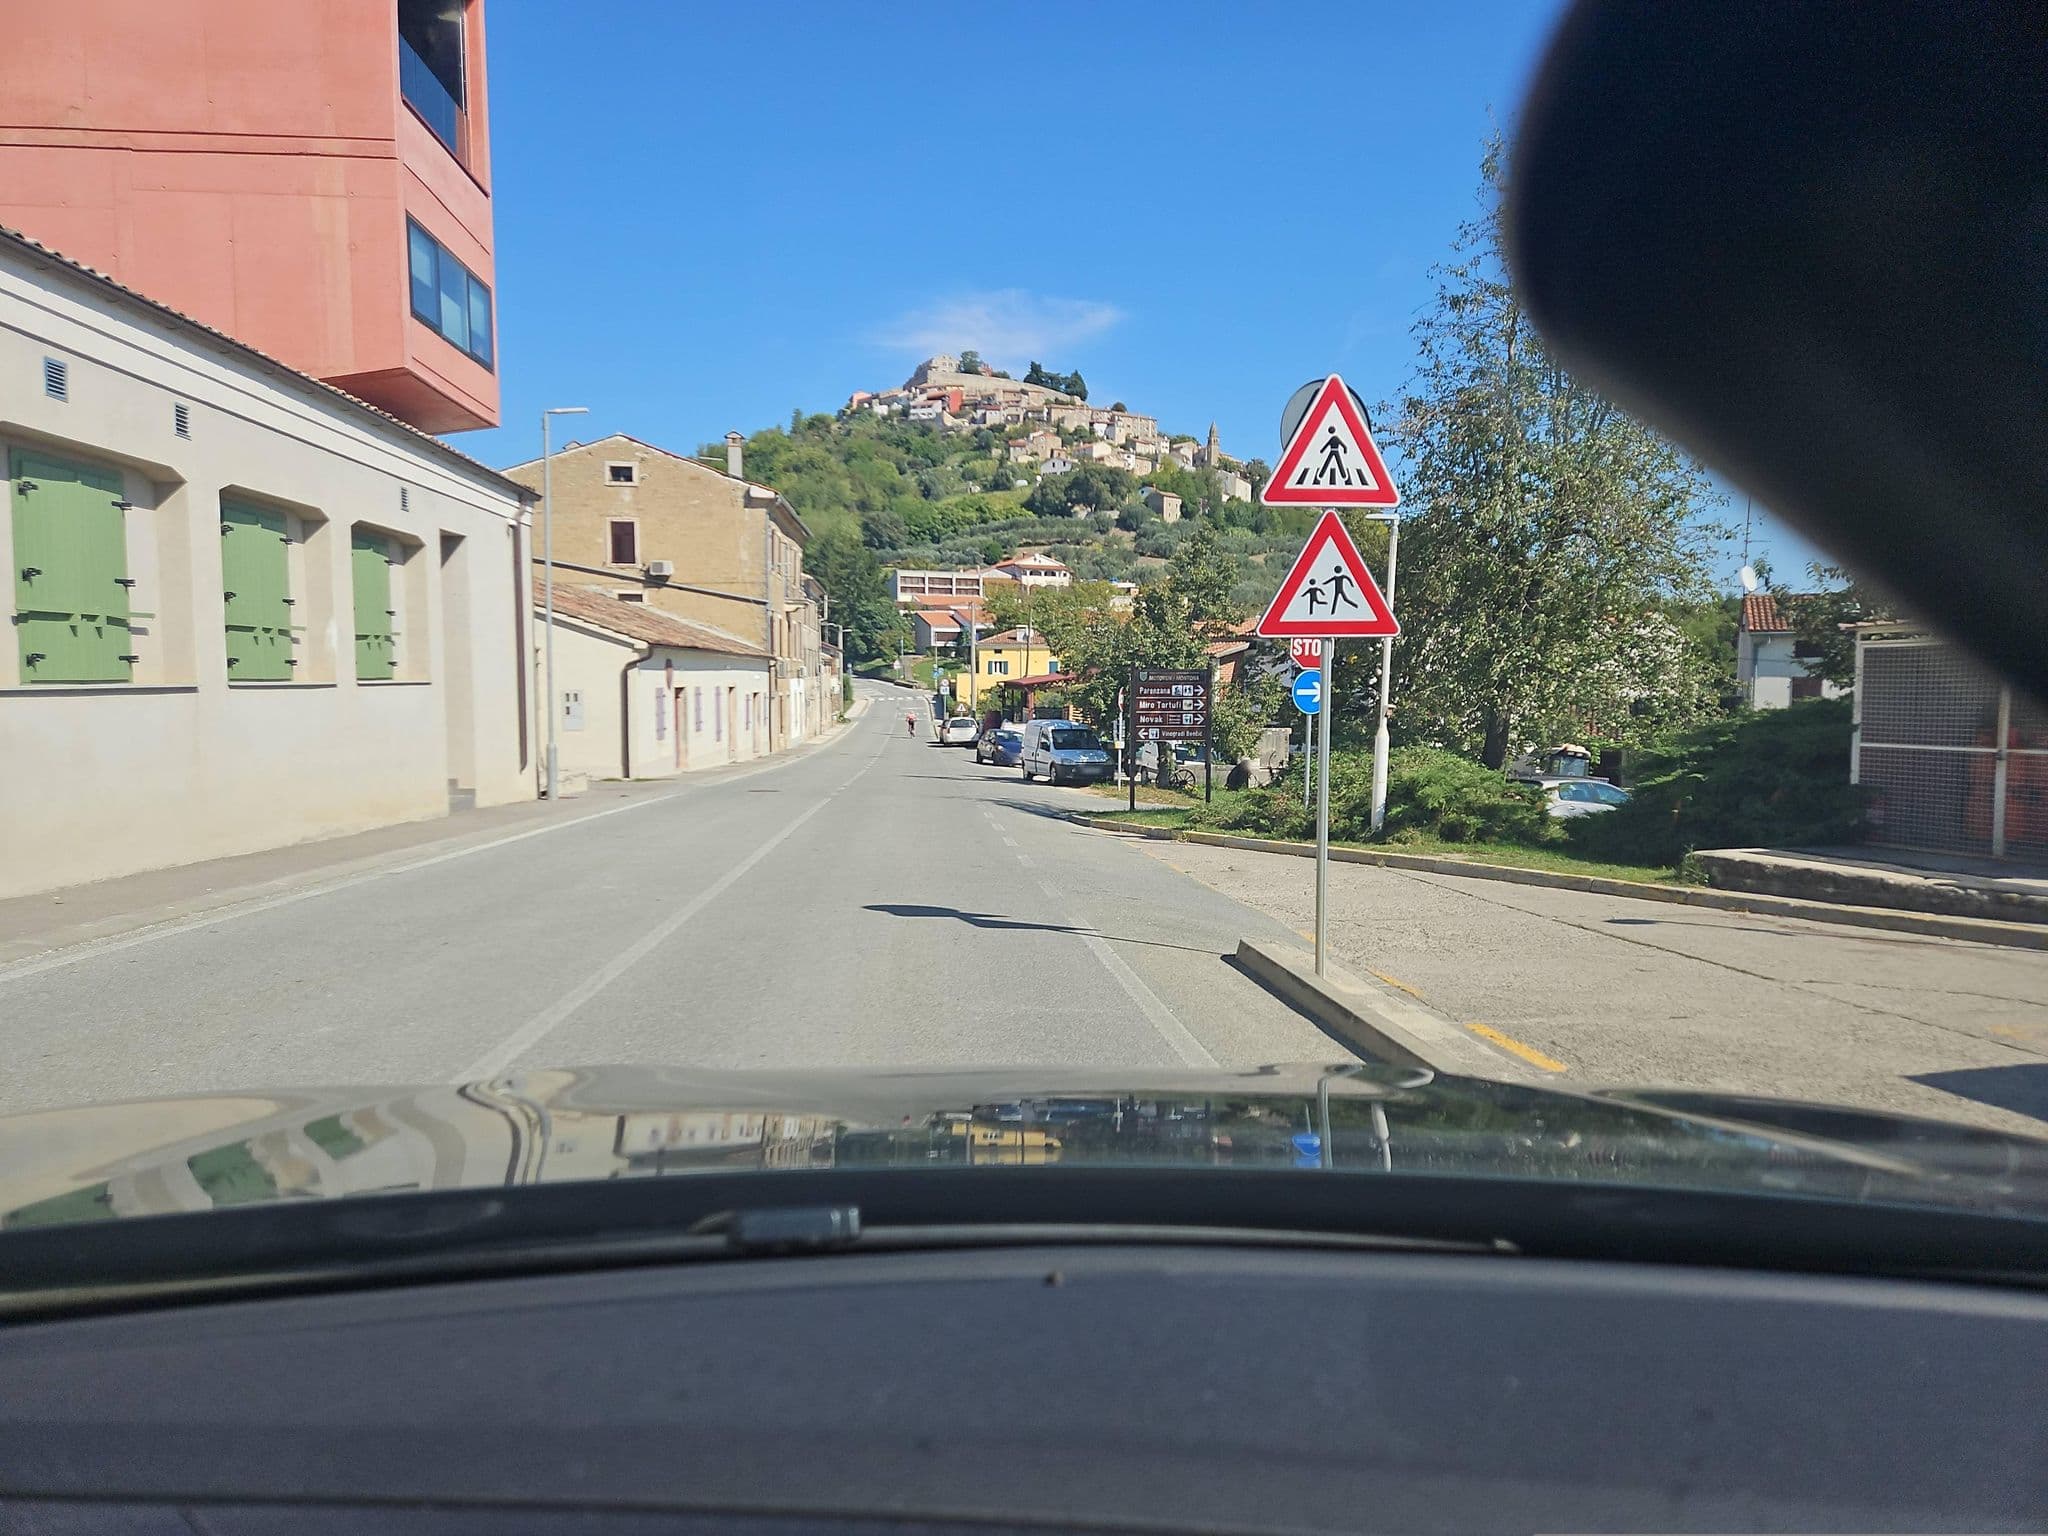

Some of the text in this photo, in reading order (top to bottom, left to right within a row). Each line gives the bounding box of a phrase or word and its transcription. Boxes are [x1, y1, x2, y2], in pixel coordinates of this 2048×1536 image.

[1293, 638, 1322, 656] STO
[1139, 686, 1170, 695] Parenzana
[1139, 701, 1155, 709] Miro
[1139, 715, 1163, 723] Novak
